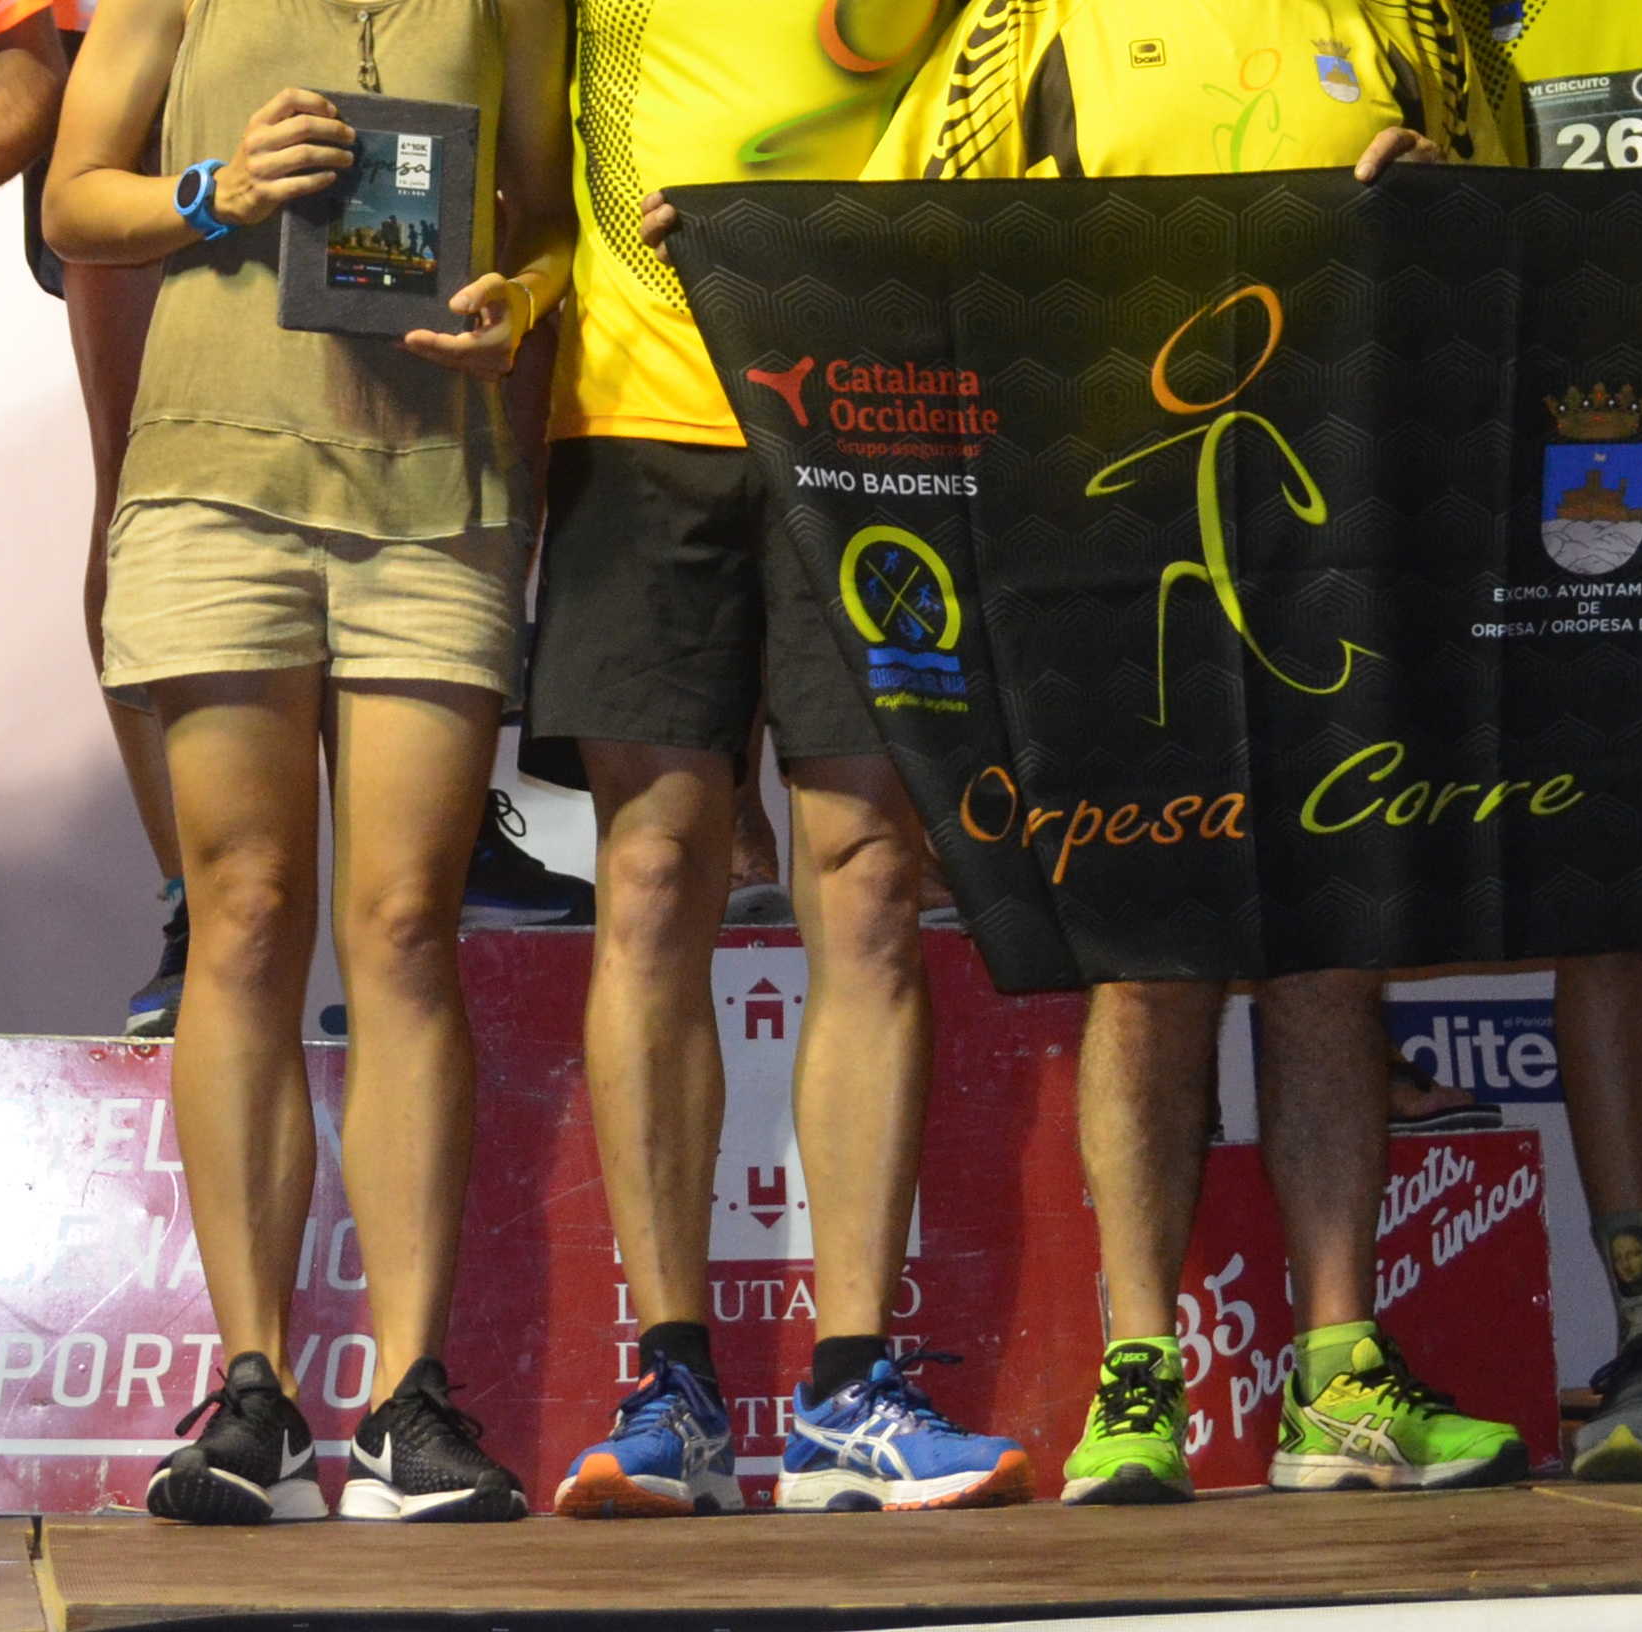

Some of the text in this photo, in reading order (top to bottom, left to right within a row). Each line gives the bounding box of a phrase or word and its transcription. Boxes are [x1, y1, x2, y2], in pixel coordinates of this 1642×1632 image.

[1544, 76, 1611, 95] CIRCUITO
[825, 359, 981, 397] Catalana
[829, 398, 999, 435] Occidente
[794, 465, 979, 497] XIMO BADENES
[1577, 602, 1601, 615] DE
[1471, 620, 1535, 638] ORPESA
[1551, 618, 1633, 634] OROPESA
[959, 741, 1584, 886] Orpesa Corre
[1432, 1166, 1538, 1266] única
